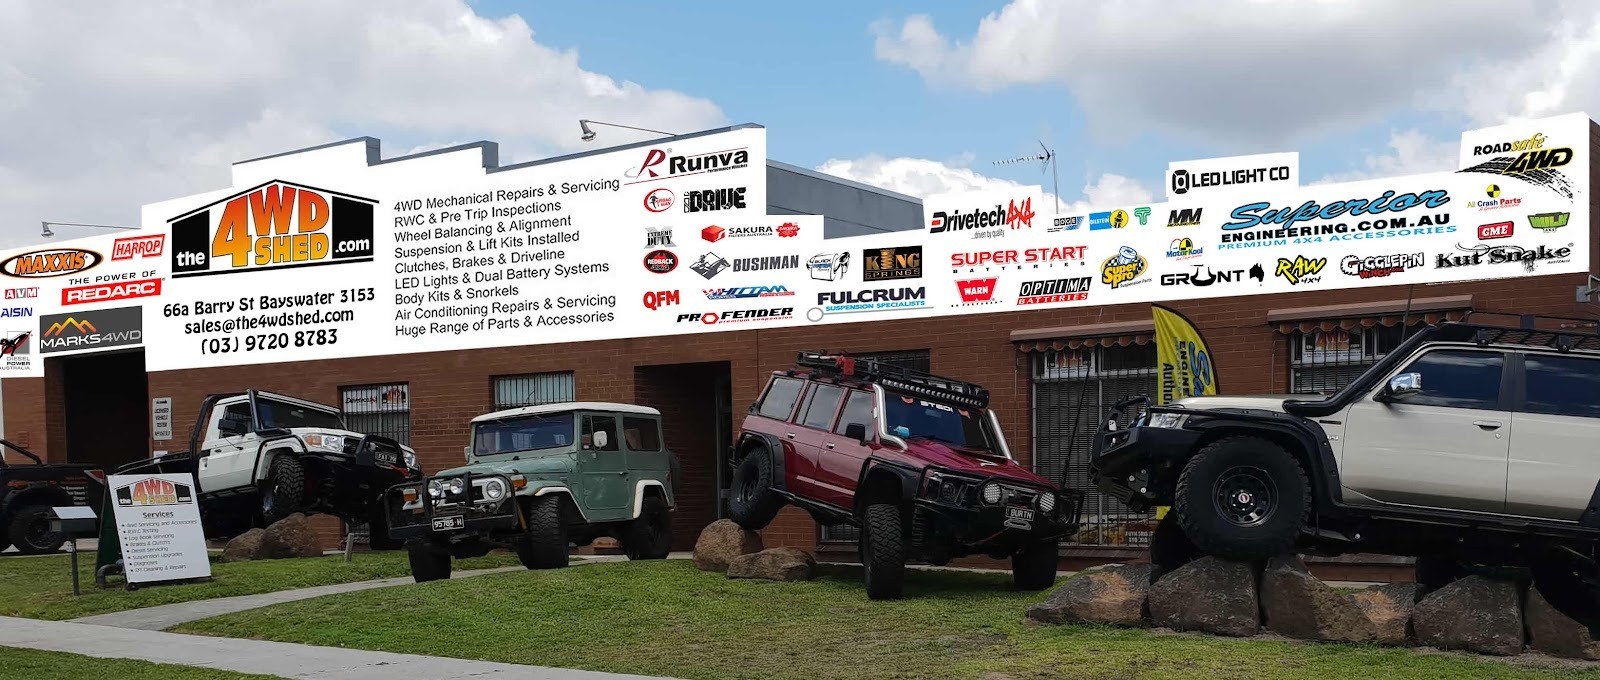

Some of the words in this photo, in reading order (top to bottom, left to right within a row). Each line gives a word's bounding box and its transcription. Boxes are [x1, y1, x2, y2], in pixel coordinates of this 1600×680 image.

[669, 150, 748, 174] Runva
[1503, 147, 1574, 174] 4WD
[1192, 172, 1220, 188] LED
[1223, 168, 1266, 185] LIGHT
[1270, 166, 1289, 180] CO
[394, 200, 422, 212] 4WD
[426, 191, 492, 209] Mechanical
[497, 187, 544, 202] Repairs
[548, 184, 557, 196] &
[561, 178, 620, 195] Servicing
[394, 215, 424, 227] RWC
[429, 214, 437, 224] &
[441, 212, 461, 223] Pre
[465, 208, 488, 221] Trip
[492, 201, 561, 218] Inspections
[1221, 190, 1450, 230] Superior
[212, 184, 329, 267] 4WD
[394, 229, 431, 242] Wheel
[435, 224, 492, 239] Balancing
[497, 222, 505, 233] &
[509, 215, 571, 232] Alignment
[728, 226, 772, 234] SAKURA
[1222, 214, 1450, 243] ENGINEERING.COM.AU
[1482, 226, 1508, 236] GME
[116, 240, 160, 256] HARROP
[255, 233, 329, 265] SHED
[335, 238, 369, 253] .com
[394, 242, 462, 259] Suspension
[467, 240, 475, 251] &
[479, 238, 497, 250] Lift
[501, 236, 523, 248] Kits
[528, 231, 580, 245] Installed
[1218, 240, 1286, 250] PREMIUM
[1330, 226, 1457, 242] ACCESSORIES
[14, 252, 86, 275] MAXXIS
[176, 251, 205, 266] the
[395, 259, 448, 274] Clutches,
[453, 255, 494, 269] Brakes
[498, 254, 506, 264] &
[511, 249, 565, 263] Driveline
[733, 255, 799, 272] BUSHMAN
[951, 250, 1018, 266] SUPER
[1024, 246, 1087, 262] START
[95, 272, 136, 282] POWER
[395, 277, 419, 289] LED
[424, 273, 458, 288] Lights
[462, 272, 471, 283] &
[475, 270, 502, 283] Dual
[507, 267, 550, 280] Battery
[554, 262, 609, 277] Systems
[865, 269, 920, 278] SPRINGS
[1275, 255, 1328, 285] RAW
[5, 288, 38, 299] AVM
[67, 282, 156, 303] REDARC
[395, 292, 424, 306] Body
[428, 290, 449, 302] Kits
[454, 288, 462, 300] &
[466, 285, 519, 299] Snorkels
[818, 287, 925, 305] FULCRUM
[964, 286, 988, 295] WARN
[1018, 293, 1088, 304] BATTERIES
[1020, 278, 1091, 296] OPTIMA
[164, 303, 189, 317] 66a
[195, 300, 234, 315] Barry
[239, 297, 254, 311] St
[260, 292, 334, 310] Bayswater
[340, 288, 375, 303] 3153
[395, 309, 410, 321] Air
[414, 303, 488, 319] Conditioning
[492, 300, 539, 314] Repairs
[544, 298, 552, 309] &
[556, 294, 616, 308] Servicing
[643, 290, 680, 310] QFM
[1, 307, 32, 318] AISIN
[185, 308, 354, 334] sales@the4wdshed.com
[395, 325, 426, 338] Huge
[430, 322, 468, 335] Range
[473, 319, 484, 330] of
[488, 317, 519, 330] Parts
[524, 315, 532, 326] &
[536, 311, 614, 327] Accessories
[201, 336, 239, 355] (03)
[246, 332, 289, 352] 9720
[294, 328, 338, 347] 8783
